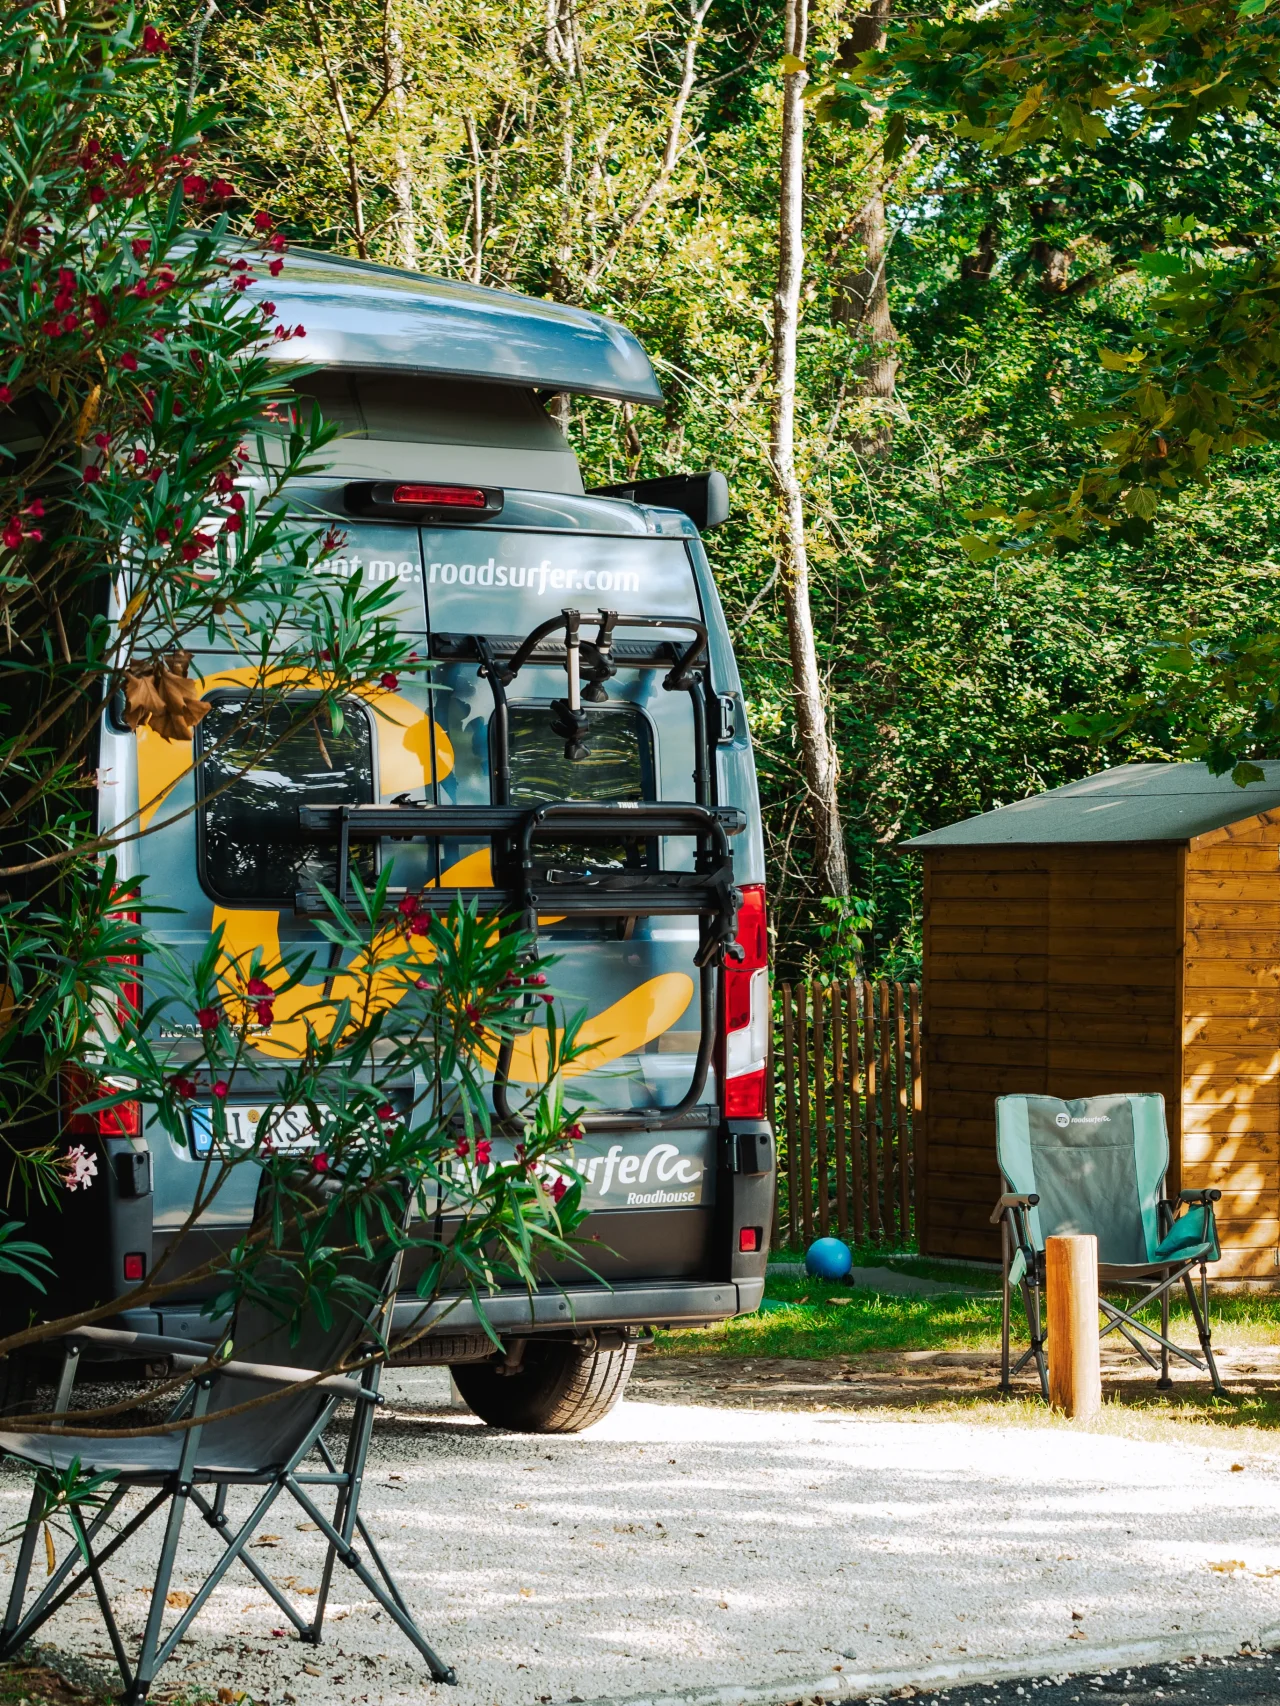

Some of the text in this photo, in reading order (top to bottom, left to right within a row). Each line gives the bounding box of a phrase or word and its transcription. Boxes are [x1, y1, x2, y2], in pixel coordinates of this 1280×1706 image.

[306, 554, 640, 596] rent me: roadsurfer.com
[627, 1191, 695, 1205] Roadhouse
